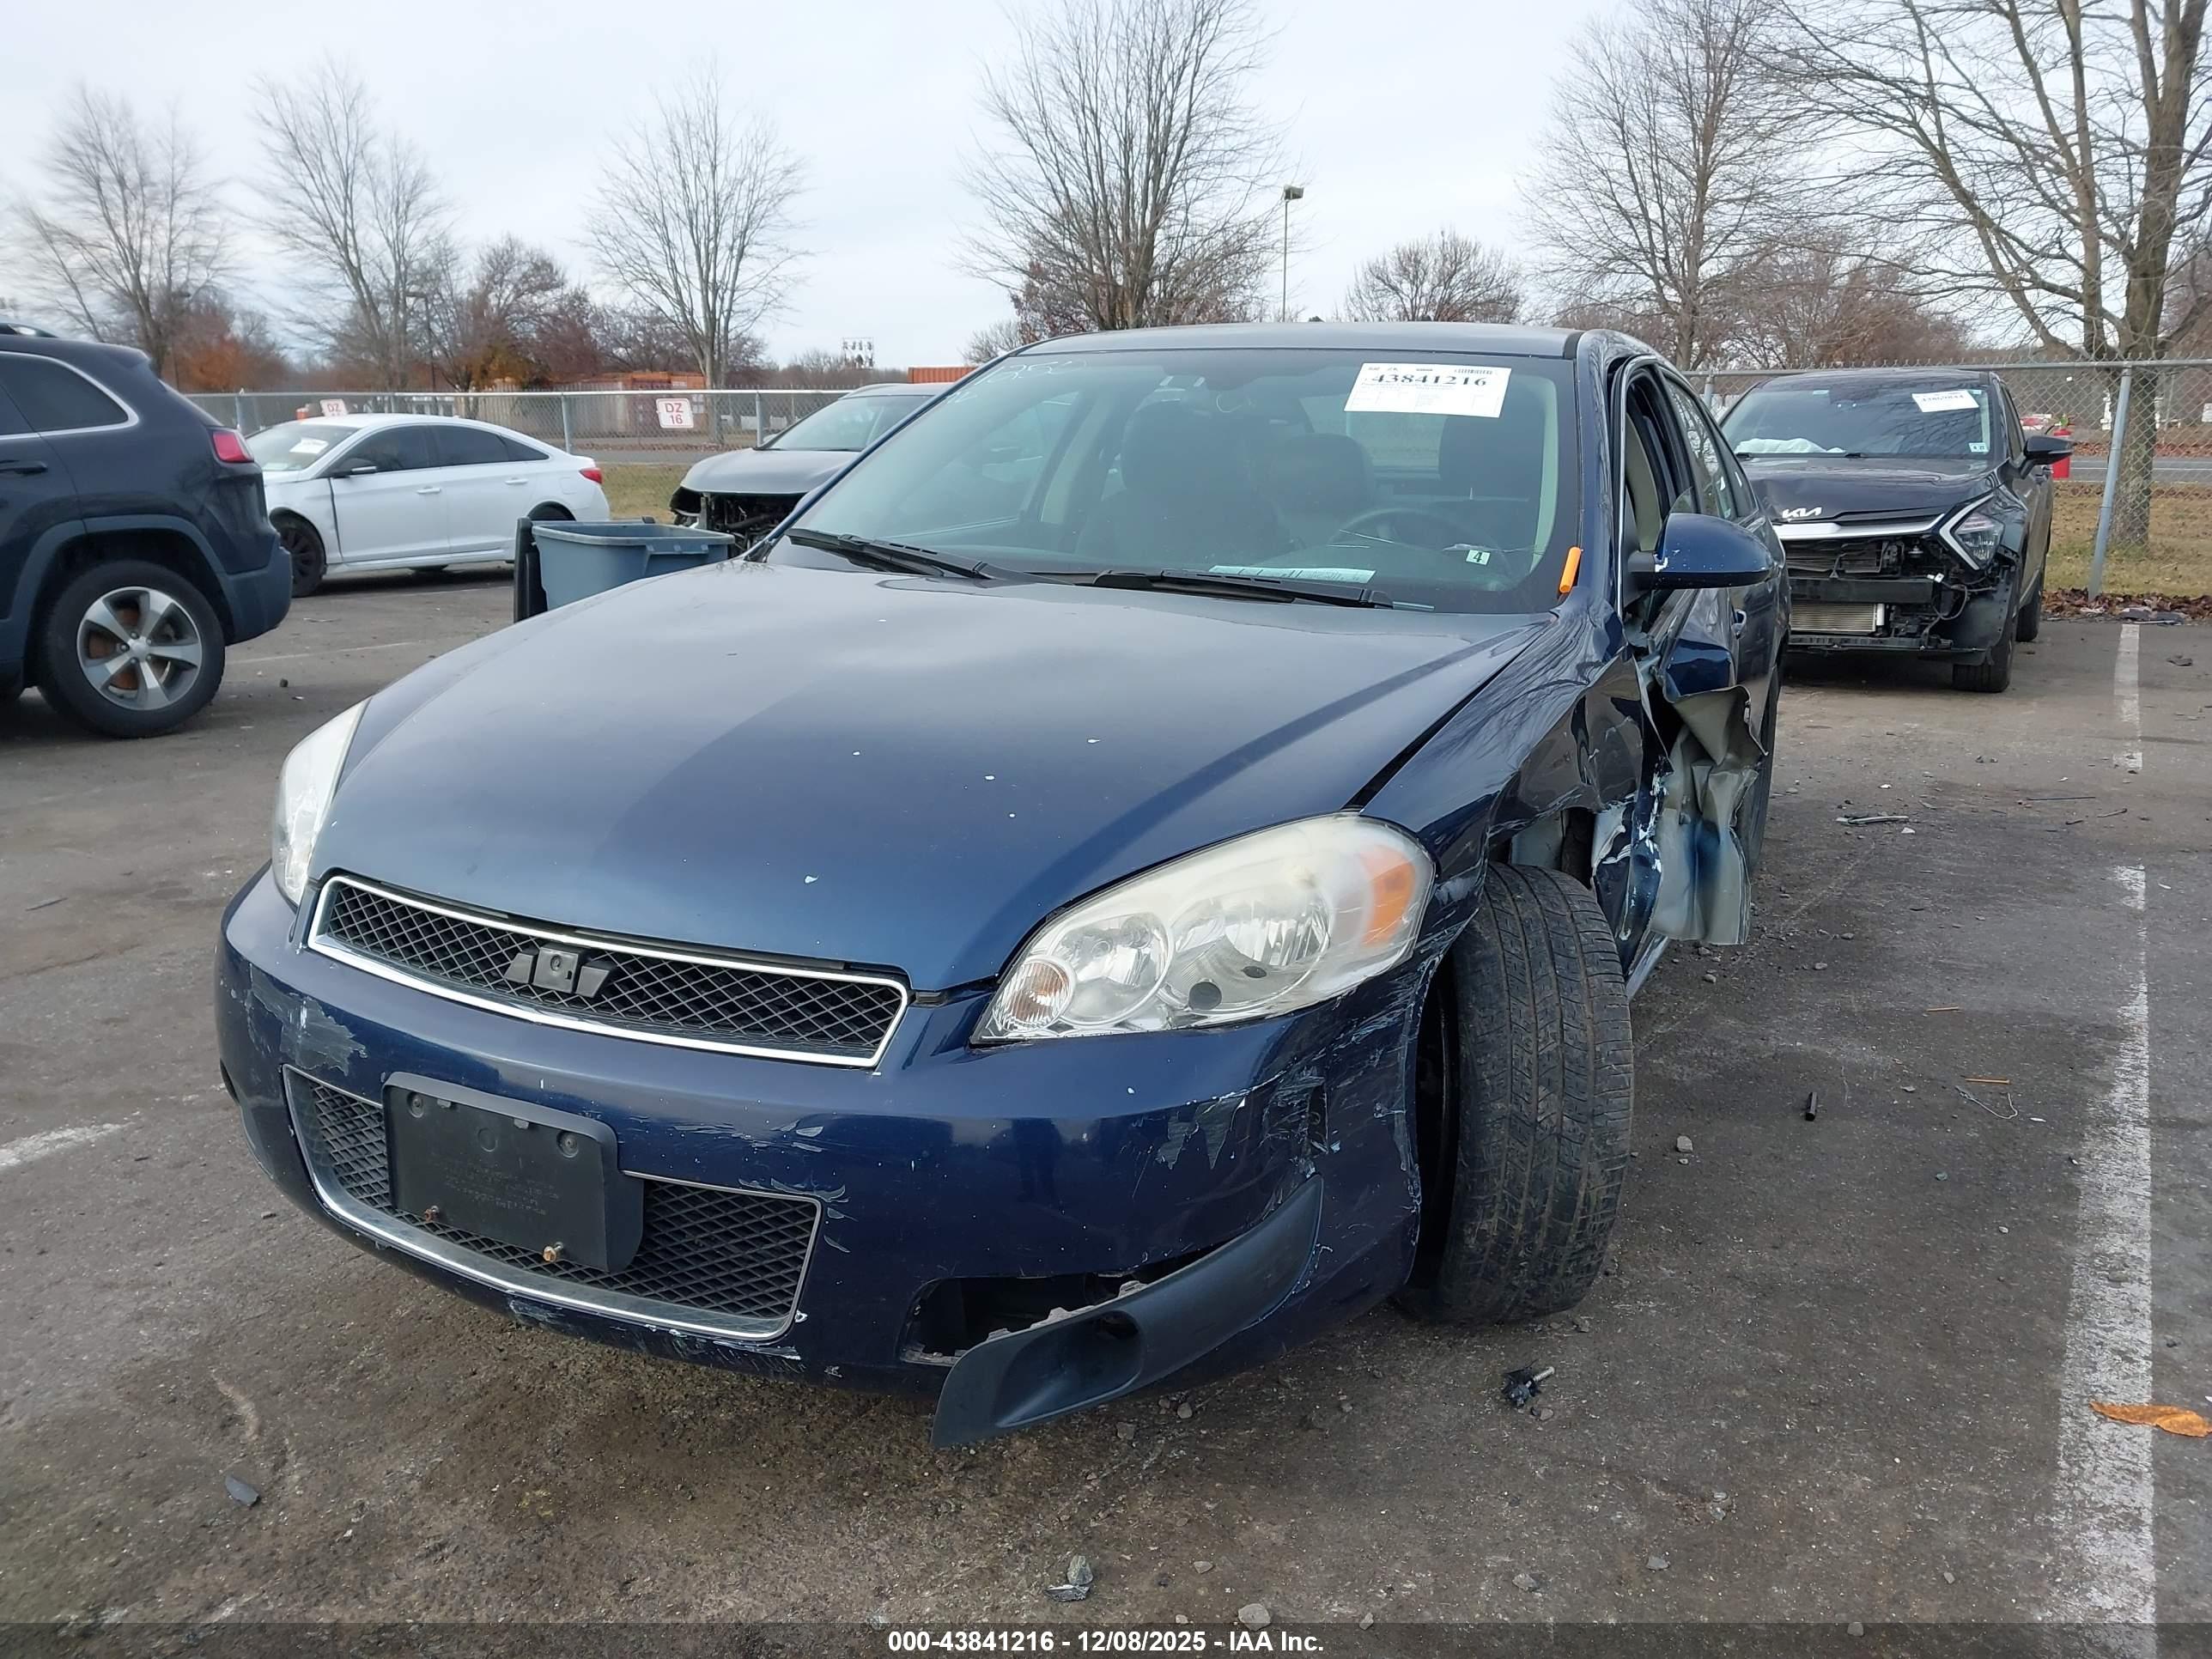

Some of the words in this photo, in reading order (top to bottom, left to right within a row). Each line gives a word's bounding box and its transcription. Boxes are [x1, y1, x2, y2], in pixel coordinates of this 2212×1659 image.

[1371, 374, 1487, 387] 43841216
[665, 403, 684, 413] DZ
[1473, 551, 1483, 563] 4
